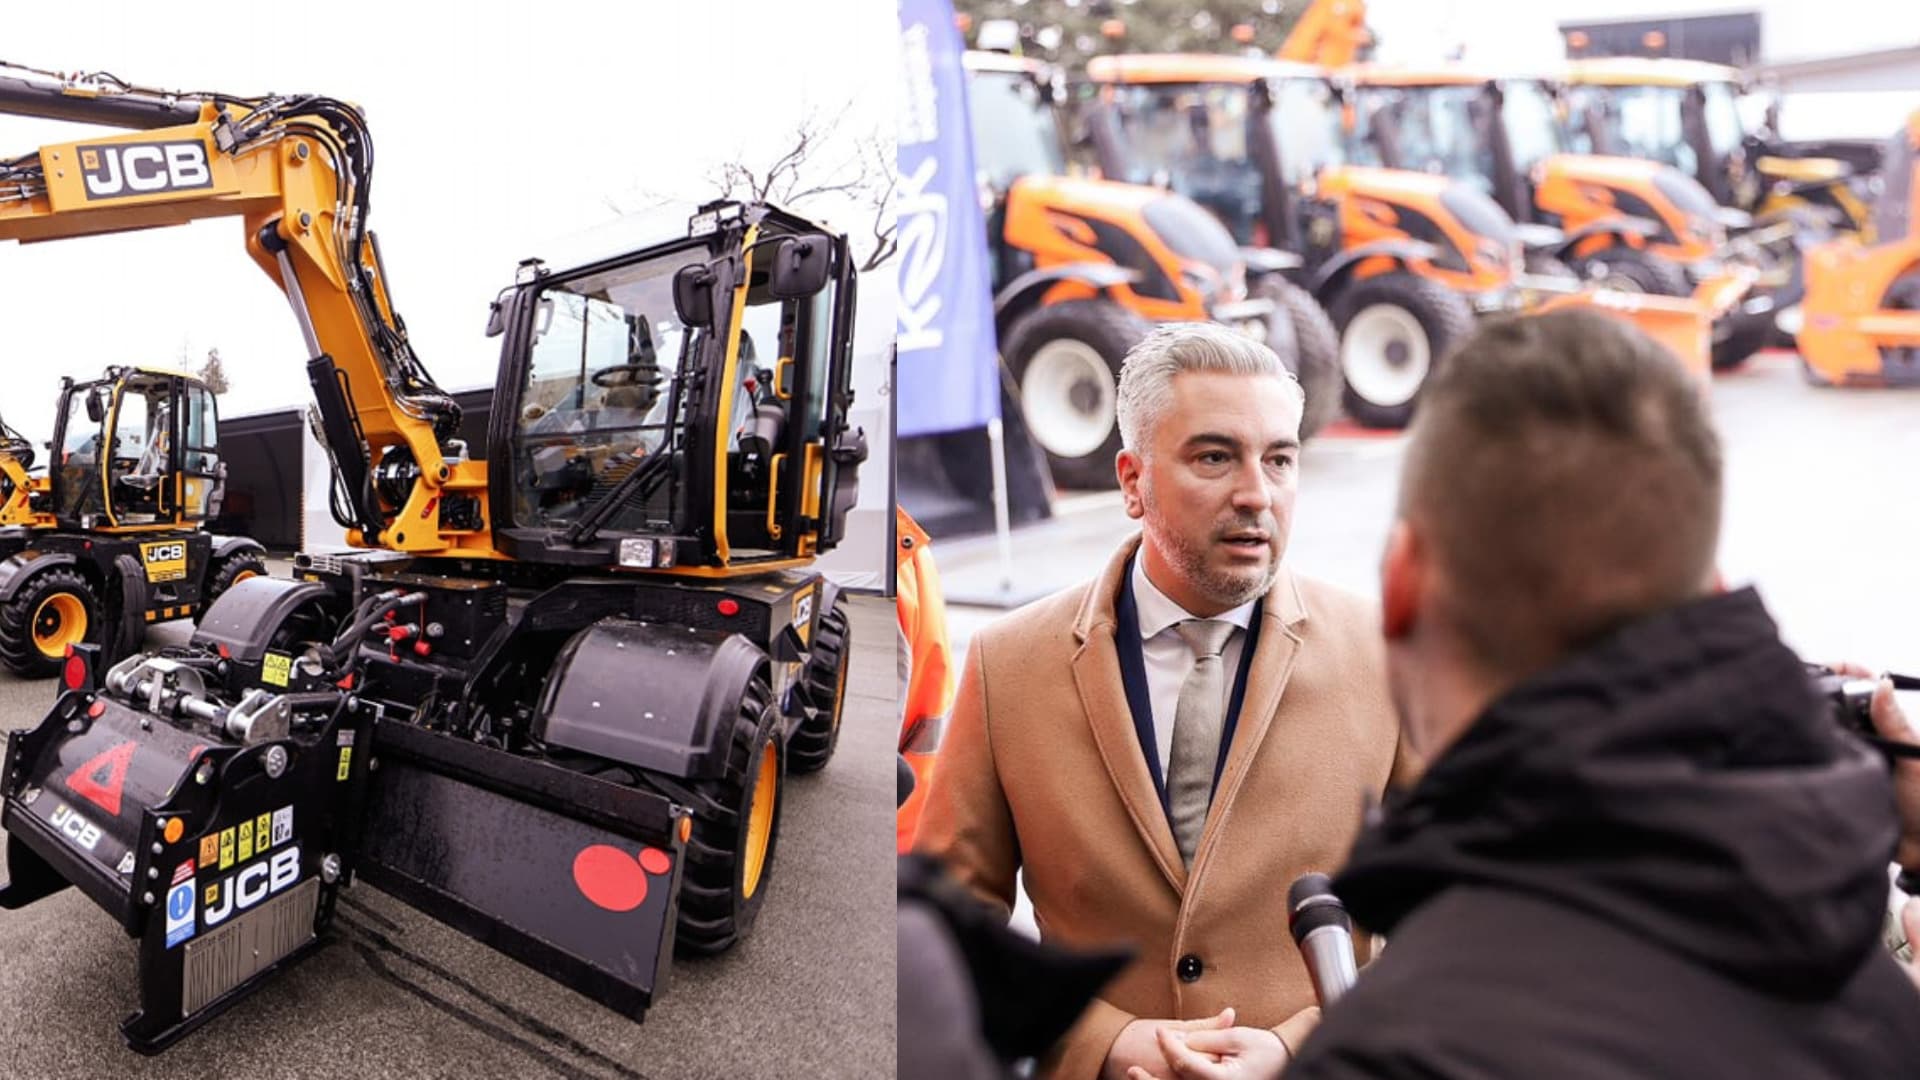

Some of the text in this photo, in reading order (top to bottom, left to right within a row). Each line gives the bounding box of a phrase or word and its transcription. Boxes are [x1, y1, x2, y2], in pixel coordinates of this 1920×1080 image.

[86, 144, 209, 194] JCB
[149, 545, 183, 561] JCB
[51, 808, 102, 851] JCB
[205, 846, 300, 925] JCB
